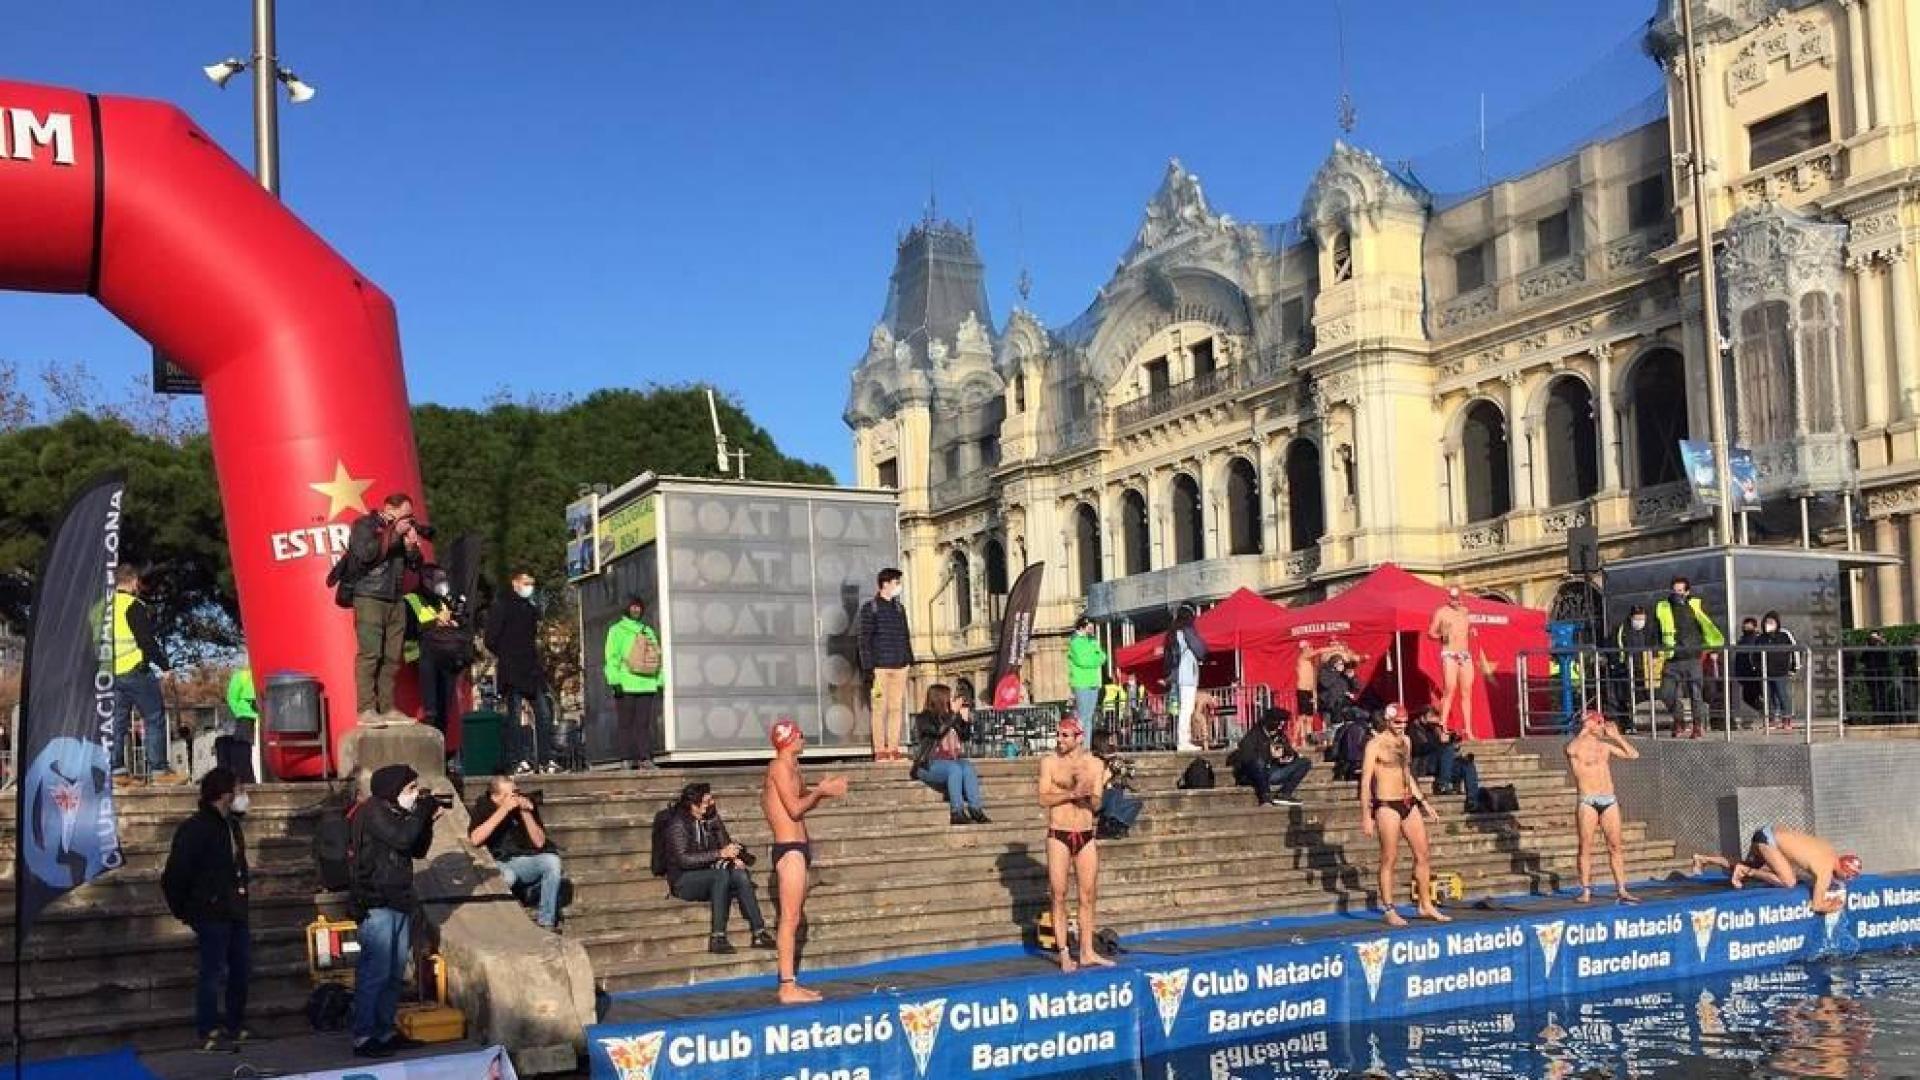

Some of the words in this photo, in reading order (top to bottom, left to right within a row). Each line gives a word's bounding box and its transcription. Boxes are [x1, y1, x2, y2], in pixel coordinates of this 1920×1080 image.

[0, 107, 75, 164] M
[669, 498, 780, 534] BOAT
[272, 523, 349, 561] ESTR
[672, 548, 783, 585] BOAT
[674, 600, 785, 635] BOAT
[677, 652, 788, 687] BOAT
[95, 670, 115, 786] TACIO
[1848, 891, 1880, 910] Club
[1883, 887, 1920, 907] Natac
[1566, 921, 1608, 946] Club
[1614, 913, 1683, 939] Natació
[1717, 907, 1756, 931] Club
[1392, 938, 1440, 964] Club
[1446, 925, 1524, 956] Natació
[1192, 968, 1249, 998] Club
[1256, 954, 1343, 989] Natació
[1407, 966, 1512, 998] Barcelona
[1578, 950, 1671, 978] Barcelona
[950, 997, 1019, 1031] Club
[1028, 981, 1133, 1020] Natació
[1209, 998, 1327, 1034] Barcelona
[668, 1030, 753, 1067] Club
[765, 1013, 893, 1055] Natació
[972, 1030, 1116, 1071] Barcelona
